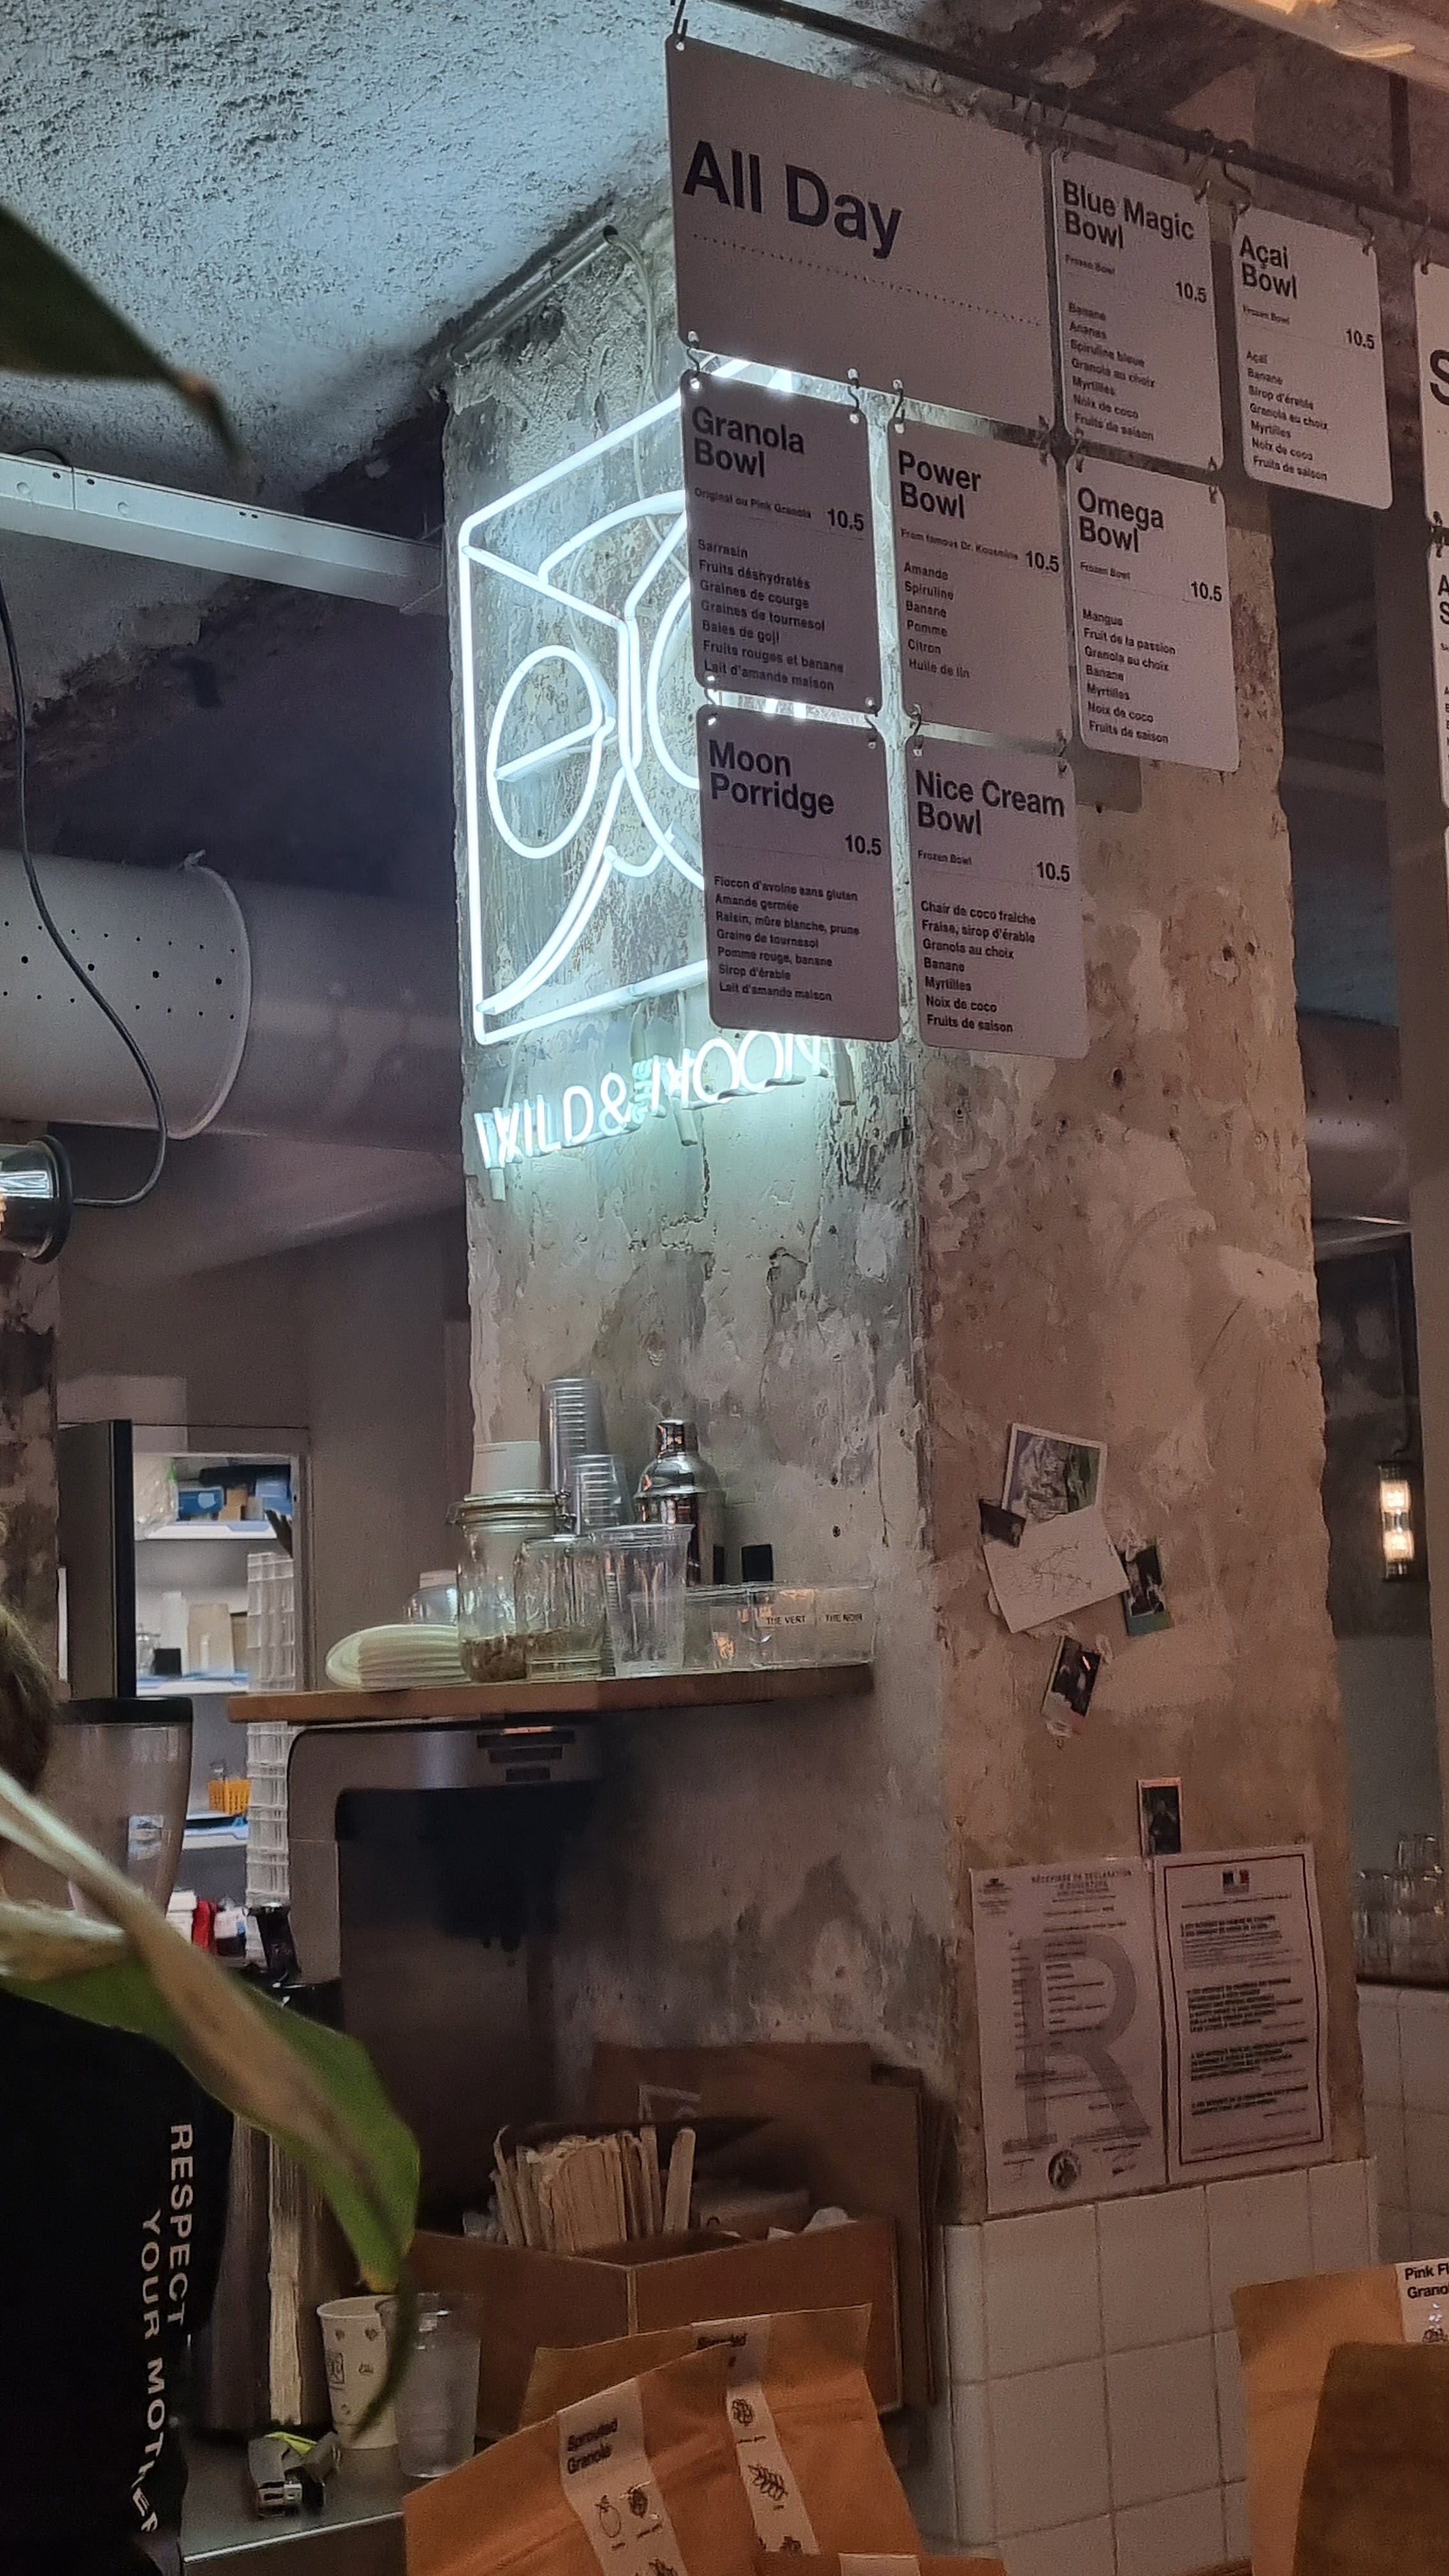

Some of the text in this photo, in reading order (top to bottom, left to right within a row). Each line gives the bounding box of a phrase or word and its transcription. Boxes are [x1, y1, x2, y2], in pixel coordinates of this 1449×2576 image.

[682, 140, 902, 259] All Day
[1062, 179, 1195, 241] Blue Magic
[1064, 208, 1124, 250] Bowl
[1239, 234, 1288, 270] Açai
[1176, 279, 1207, 304] 10.5
[1241, 261, 1298, 300] Bowl
[1345, 327, 1376, 351] 10.5
[1071, 357, 1111, 376] Granola
[1114, 371, 1126, 380] au
[1073, 394, 1138, 420] Noix de coco
[1250, 402, 1328, 431] Granola au choix
[692, 405, 806, 456] Granola
[1074, 411, 1154, 442] Fruits de saison
[1250, 420, 1291, 439] Myrtilles
[694, 436, 765, 478] Bowl
[1252, 437, 1273, 452] Noix
[1275, 443, 1287, 455] de
[898, 449, 981, 492] Power
[1253, 454, 1327, 482] Fruits de saison
[735, 496, 748, 507] ou
[900, 480, 965, 519] Bowl
[1077, 487, 1164, 532] Omega
[827, 507, 864, 532] 10.5
[1078, 516, 1139, 553] Bowl
[698, 539, 747, 559] Sarrasin
[1025, 549, 1059, 573] 10.5
[699, 559, 733, 576] Fruits
[903, 561, 948, 580] Amande
[700, 579, 809, 610] Graines de courge
[905, 580, 954, 601] Spiruline
[1190, 581, 1222, 602] 10.5
[701, 599, 825, 631] Graines de tournesol
[906, 599, 946, 618] Banane
[702, 619, 779, 645] Baies de goji
[907, 619, 947, 637] Pomme
[907, 638, 941, 655] Citron
[1084, 627, 1176, 655] Fruit de la passion
[703, 640, 843, 673] Fruits rouges et banane
[908, 658, 970, 678] Huile de lin
[1084, 645, 1169, 671] Granola au choix
[704, 659, 834, 691] Lait d'amande maison
[1085, 664, 1123, 682] Banane
[1087, 682, 1130, 700] Myrtilles
[1113, 706, 1127, 719] de
[1128, 710, 1153, 723] coco
[1089, 719, 1169, 746] Fruits de saison
[709, 739, 791, 778] Moon
[710, 772, 834, 819] Porridge
[916, 769, 1065, 817] Nice Cream
[917, 801, 981, 836] Bowl
[845, 833, 882, 856] 10.5
[1036, 861, 1070, 882] 10.5
[714, 875, 749, 889] Flocon
[799, 886, 824, 897] sans
[715, 894, 757, 907] Amande
[921, 900, 996, 920] Chair de coco
[716, 910, 860, 935] Raisin, mûre blanche, prune
[962, 924, 989, 940] sirop
[992, 928, 1035, 943] d'érable
[716, 928, 818, 948] Graine de tournesol
[923, 938, 1014, 960] Granola au choix
[717, 946, 832, 967] Pomme rouge, banane
[924, 957, 965, 972] Banane
[719, 963, 746, 978] Sirop
[719, 981, 832, 1002] Lait d'amande maison
[924, 976, 971, 991] Myrtilles
[925, 994, 997, 1013] Noix de coco
[926, 1013, 1013, 1033] Fruits de saison
[474, 1085, 594, 1169] WILD
[598, 1072, 631, 1136] &
[651, 1031, 829, 1110] MOON
[785, 1615, 806, 1624] VERT
[167, 2124, 193, 2326] RESPECT
[142, 2209, 161, 2340] YOUR
[1405, 2266, 1434, 2280] Pink
